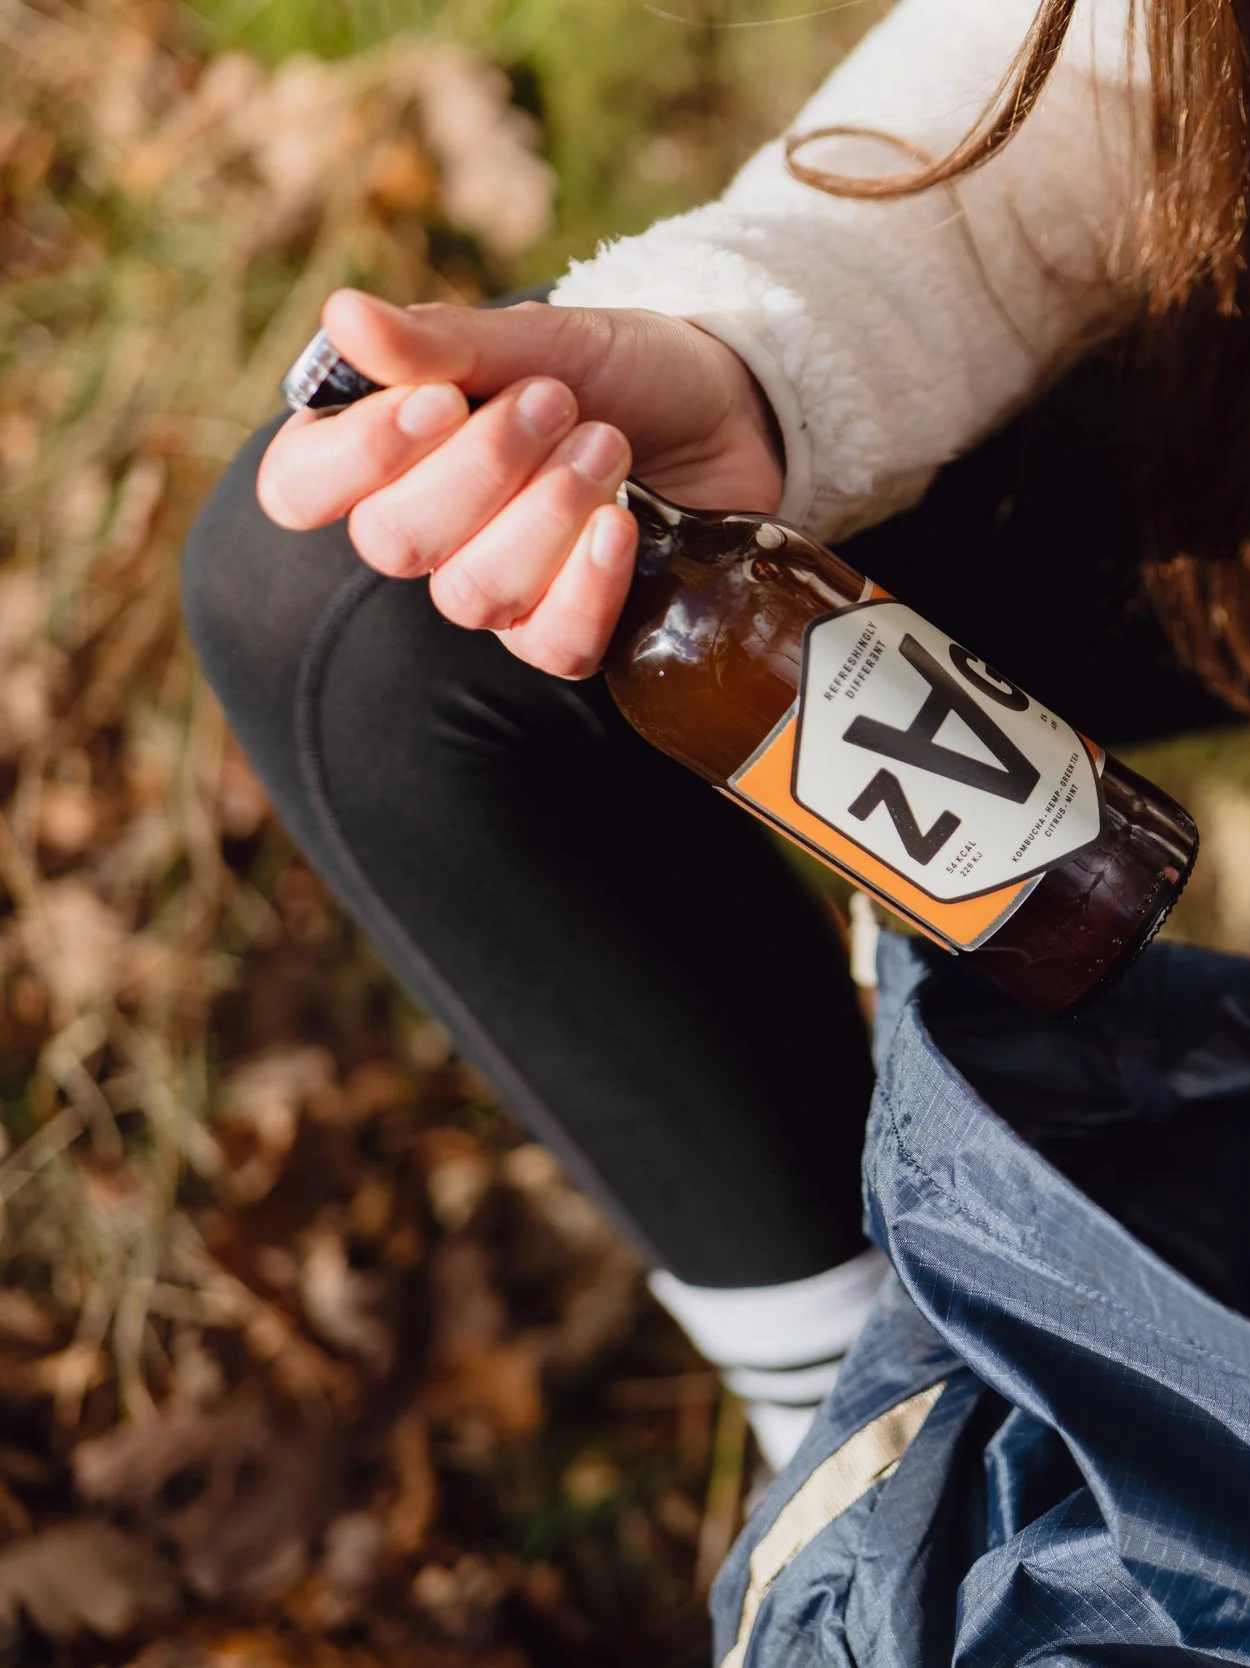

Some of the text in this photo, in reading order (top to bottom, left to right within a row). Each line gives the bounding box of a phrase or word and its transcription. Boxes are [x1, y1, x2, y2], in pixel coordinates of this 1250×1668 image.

[823, 620, 878, 701] REFRESHINGLY
[1011, 752, 1080, 863] KOMBUCHA HEMP GREEN TEA
[1044, 783, 1079, 838] CITRUS MINT
[945, 840, 977, 874] 54 KCAL
[972, 851, 983, 863] KJ
